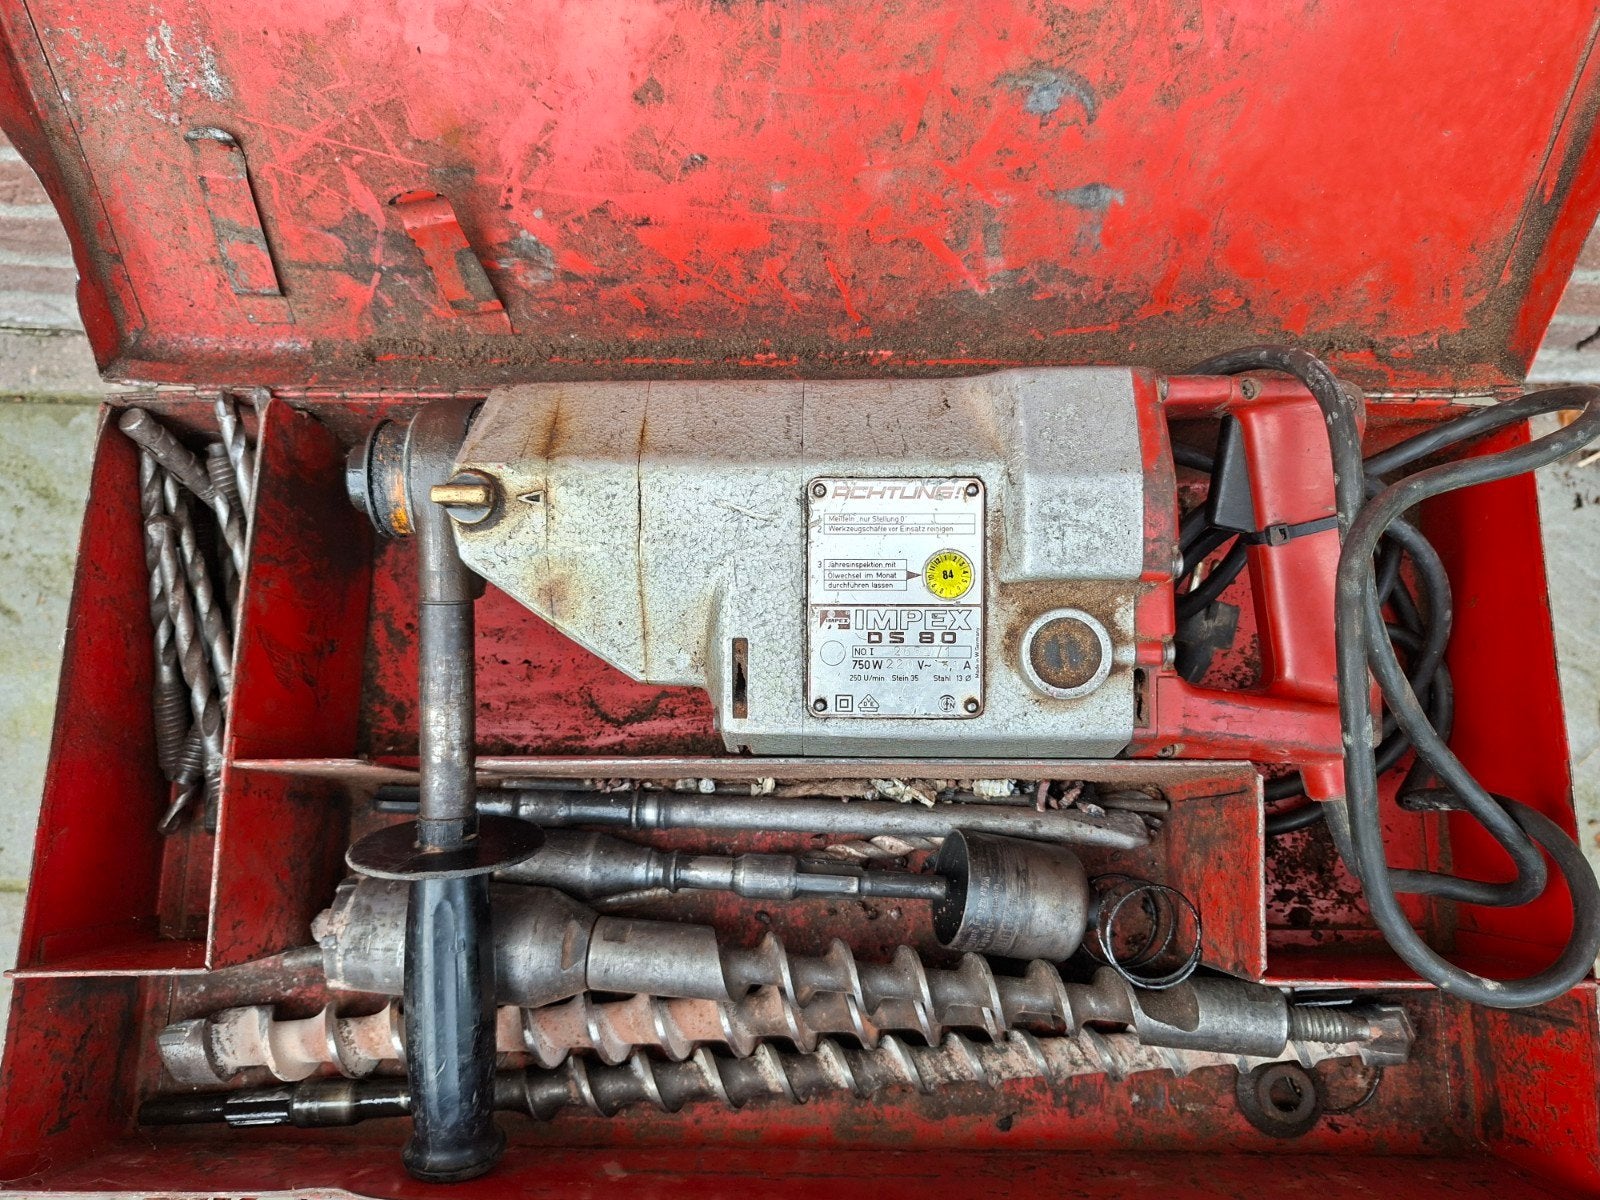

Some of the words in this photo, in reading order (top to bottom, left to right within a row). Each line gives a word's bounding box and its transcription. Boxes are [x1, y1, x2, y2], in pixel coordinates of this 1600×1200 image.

[832, 486, 961, 500] ACHTUNG!
[872, 515, 899, 525] Stellung
[927, 525, 954, 534] reinigen
[942, 569, 954, 580] 84
[855, 609, 972, 630] IMPEX
[868, 631, 904, 644] DS
[919, 631, 956, 644] 80
[852, 660, 871, 670] 750
[872, 660, 883, 670] W
[963, 660, 971, 670] A
[864, 674, 885, 682] U/min
[933, 674, 951, 682] Stahl
